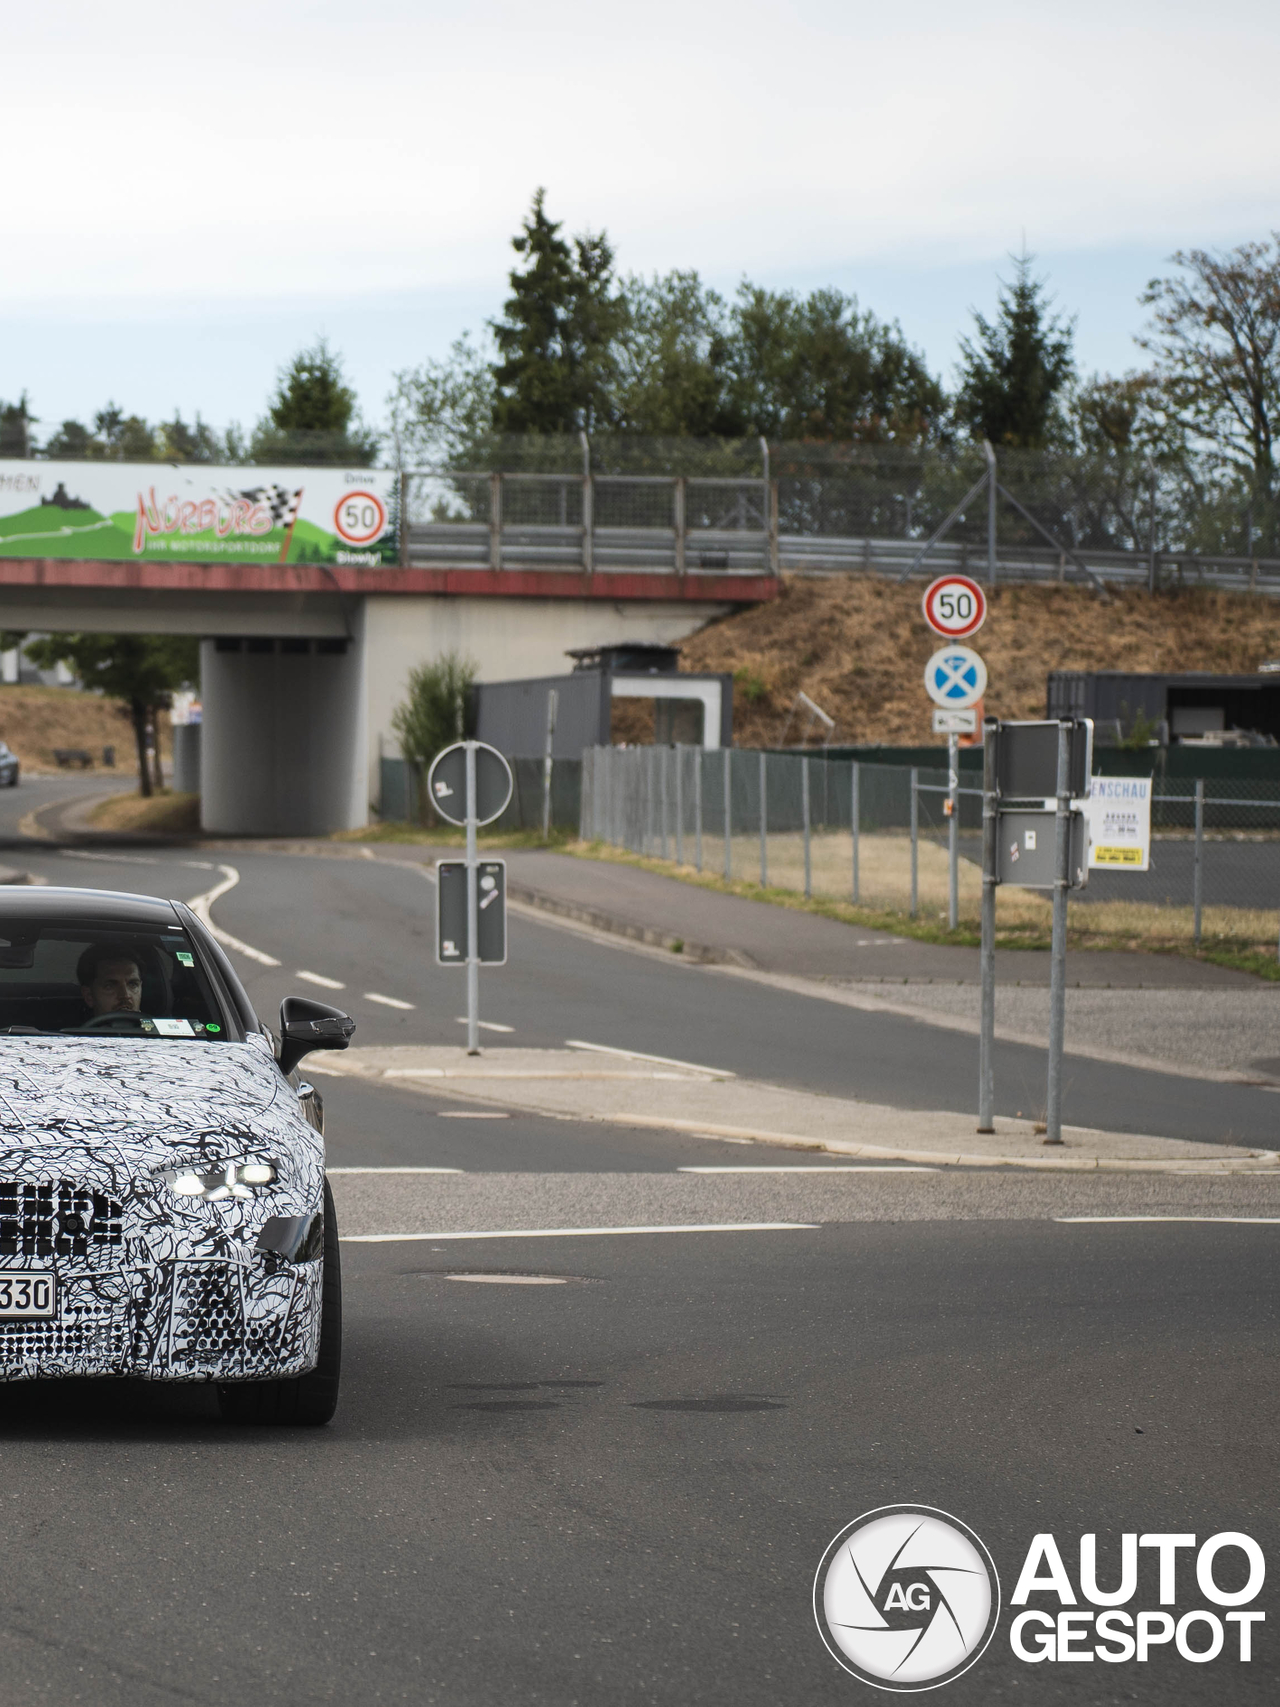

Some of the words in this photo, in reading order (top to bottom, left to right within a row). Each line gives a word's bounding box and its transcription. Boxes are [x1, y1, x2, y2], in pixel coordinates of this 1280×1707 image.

[344, 472, 376, 484] Drive
[133, 486, 273, 553] NÜRBURG
[345, 504, 376, 528] 50
[336, 551, 382, 566] Slowly!
[939, 593, 972, 619] 50
[1092, 781, 1147, 798] ENSCHAU
